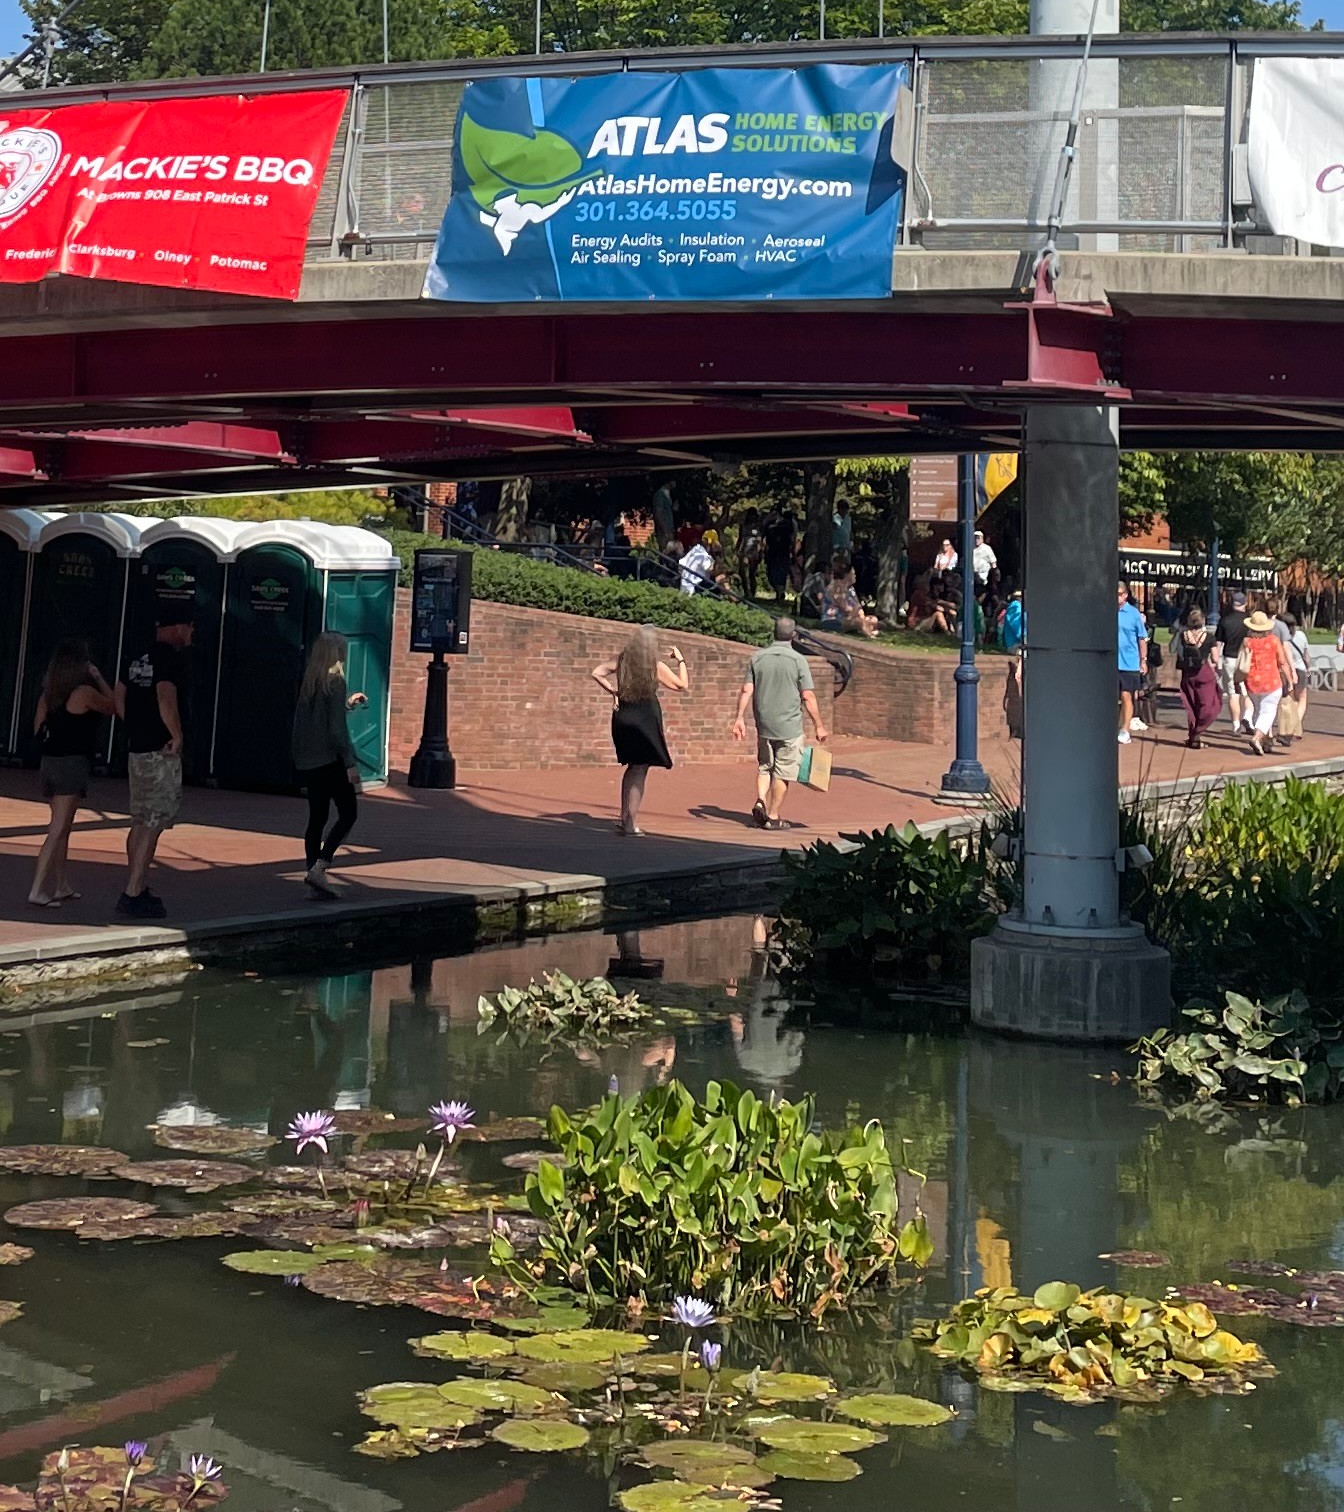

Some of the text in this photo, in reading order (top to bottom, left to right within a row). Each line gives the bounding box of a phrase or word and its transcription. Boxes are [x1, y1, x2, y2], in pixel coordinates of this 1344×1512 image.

[734, 111, 890, 132] HOME ENERGY
[586, 112, 732, 159] ATLAS
[731, 135, 857, 154] SOLUTIONS
[70, 155, 230, 182] MACKIE'S
[233, 156, 314, 185] BBQ
[77, 187, 95, 201] At
[144, 189, 171, 201] 908
[173, 189, 202, 202] East
[204, 191, 251, 205] Patrick
[253, 194, 269, 207] St
[577, 172, 852, 200] AtlasHomeEnergy.com
[575, 200, 736, 223] 301.364.5055
[572, 232, 825, 250] Energy Audits Insulation Aeroseal
[5, 248, 58, 261] Frederic
[69, 243, 136, 260] Clarksburg
[154, 250, 192, 265] Olney
[210, 254, 268, 271] Potomac
[571, 249, 797, 268] Air Sealing Spray Foam HVAC
